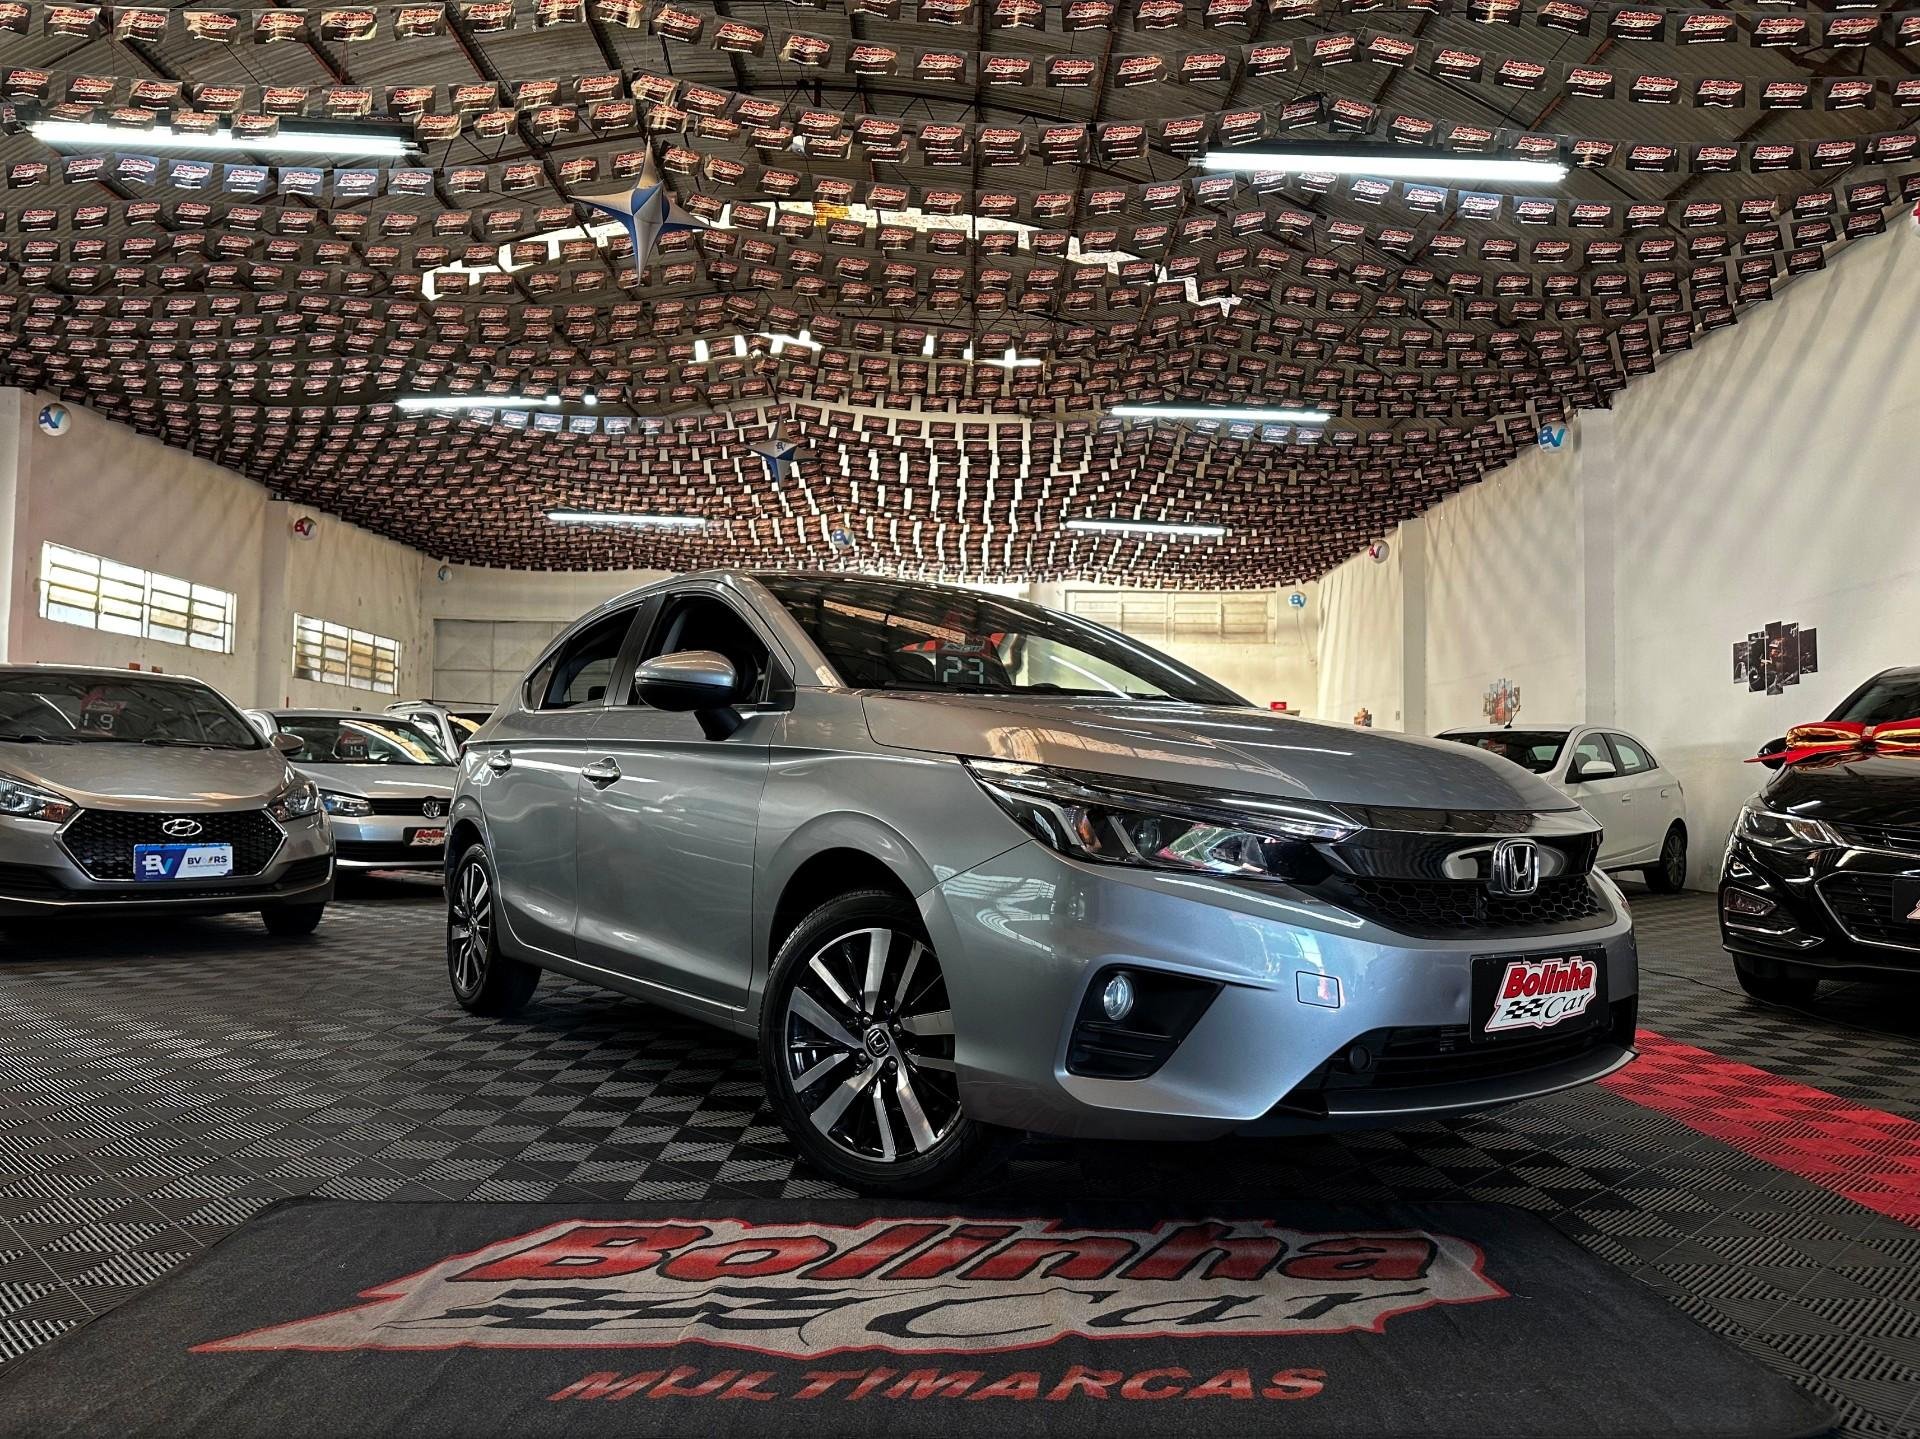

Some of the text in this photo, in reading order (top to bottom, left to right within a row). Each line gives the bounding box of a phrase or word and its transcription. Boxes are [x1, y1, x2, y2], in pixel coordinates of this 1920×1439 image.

[1539, 426, 1565, 447] BV
[1503, 962, 1593, 999] Bolinha
[1545, 992, 1590, 1019] Car
[445, 1223, 1437, 1282] Bolinha
[865, 1287, 1431, 1338] Car
[546, 1365, 1327, 1401] MULTIMARCAS
